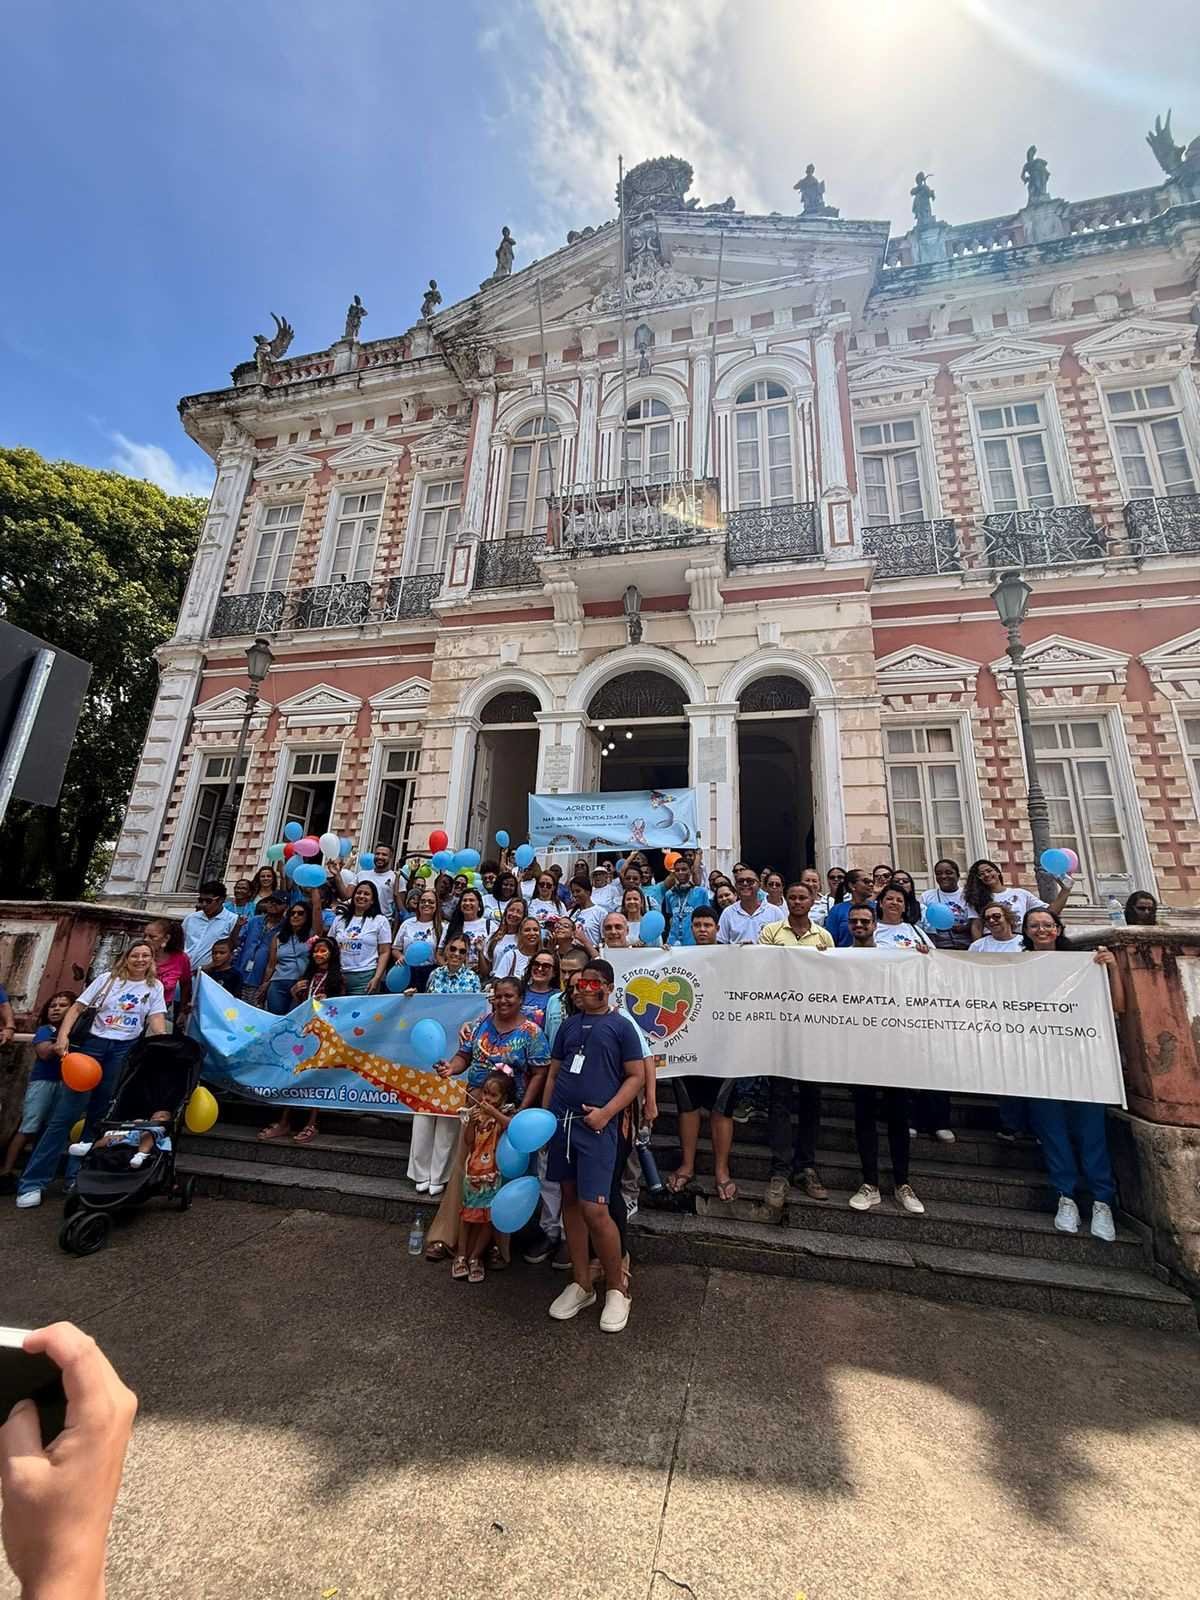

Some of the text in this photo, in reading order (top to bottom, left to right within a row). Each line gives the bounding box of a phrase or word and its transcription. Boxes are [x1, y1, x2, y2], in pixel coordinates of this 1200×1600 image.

[565, 804, 606, 812] ACREDITE
[622, 967, 660, 983] Entenda
[688, 993, 704, 1022] Inclua
[724, 990, 804, 1002] "INFORMAÇÃO
[808, 993, 838, 1003] GERA
[905, 996, 961, 1008] EMPATIA
[965, 999, 998, 1010] GERA
[712, 1010, 1102, 1039] 02 DE ABRIL DIA MUNDIAL DE CONSCIENTIZAÇÃO DO AUTISMO.
[254, 1087, 279, 1098] NOS
[281, 1087, 336, 1100] CONECTA
[339, 1085, 347, 1100] É
[348, 1089, 358, 1101] O
[360, 1090, 398, 1104] AMOR
